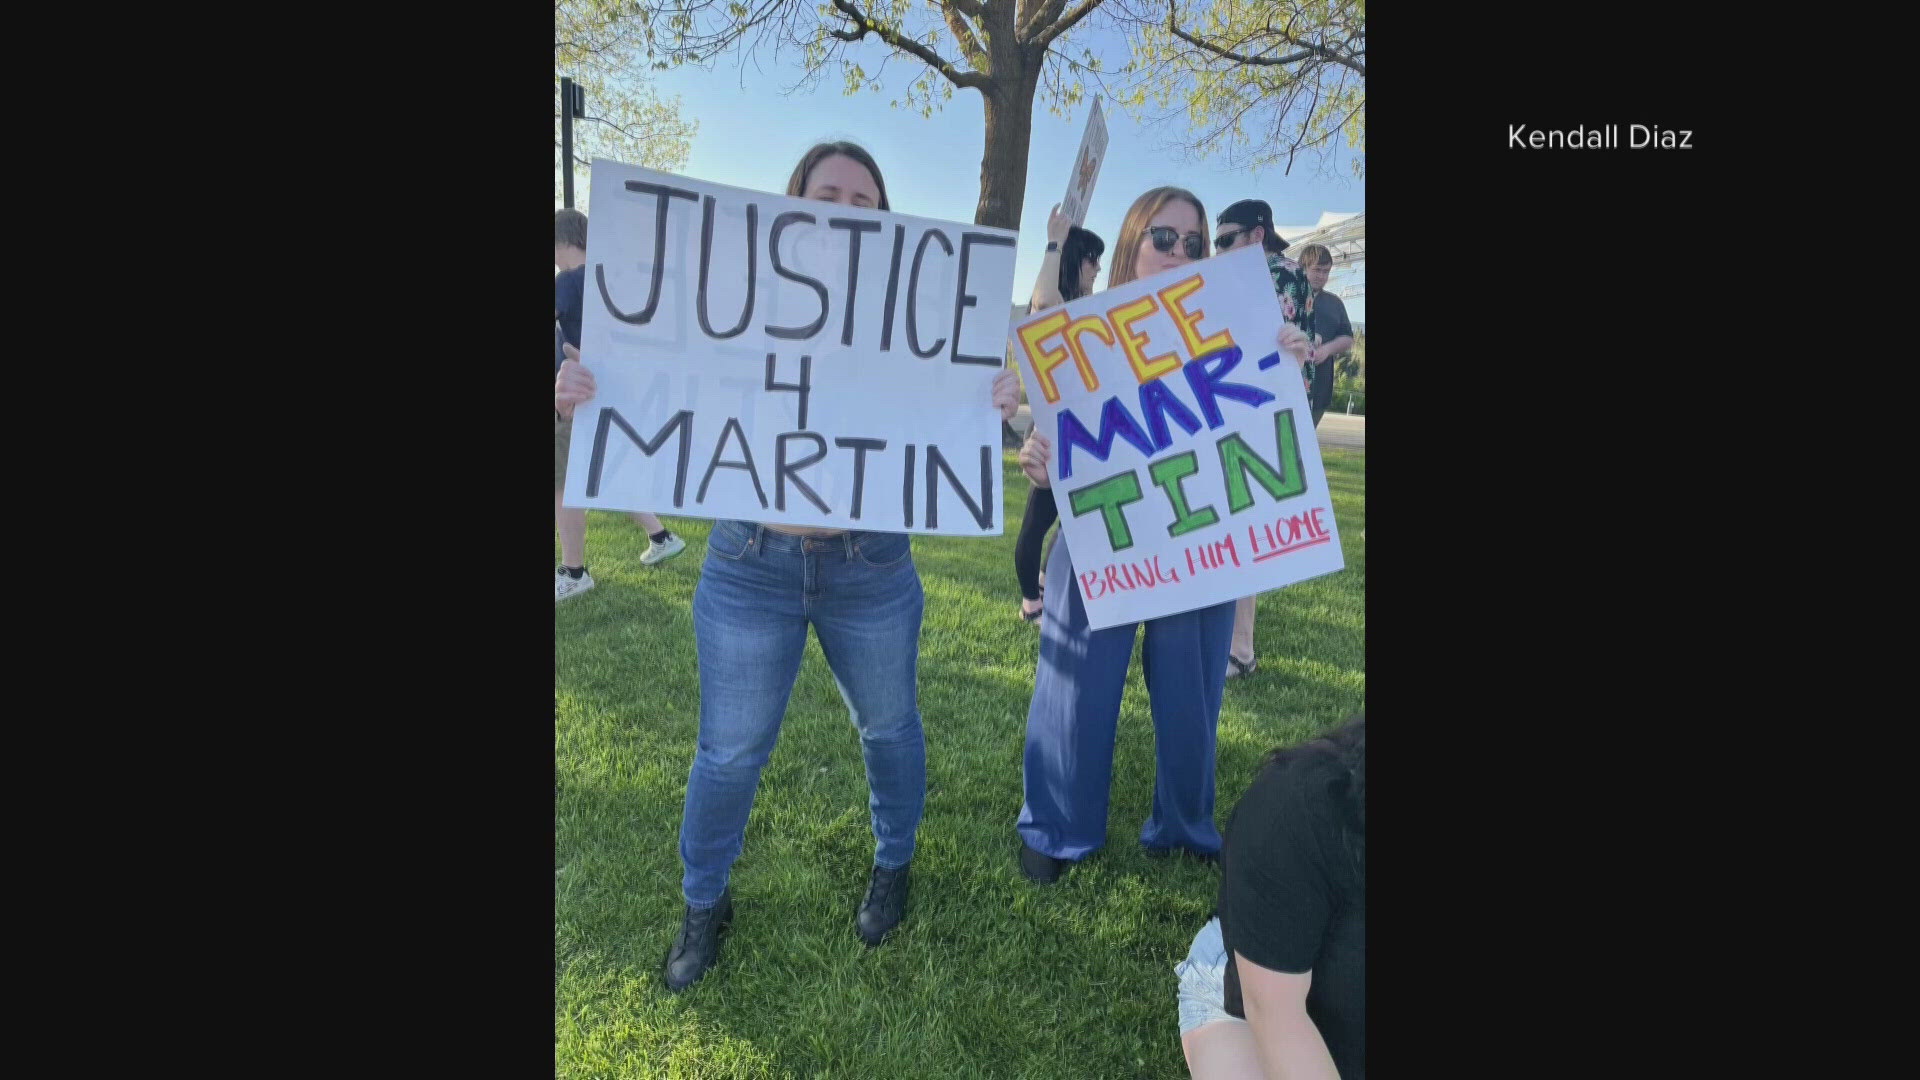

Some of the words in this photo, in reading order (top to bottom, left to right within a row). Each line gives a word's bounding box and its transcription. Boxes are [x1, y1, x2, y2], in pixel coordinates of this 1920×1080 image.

[596, 181, 1016, 366] JUSTICE
[765, 353, 811, 430] 4
[1057, 345, 1281, 480] MAR-
[586, 407, 994, 530] MARTIN
[1068, 408, 1308, 551] TIN
[1079, 555, 1181, 601] BRING
[1185, 533, 1241, 576] HIM
[1248, 507, 1330, 556] HOME
